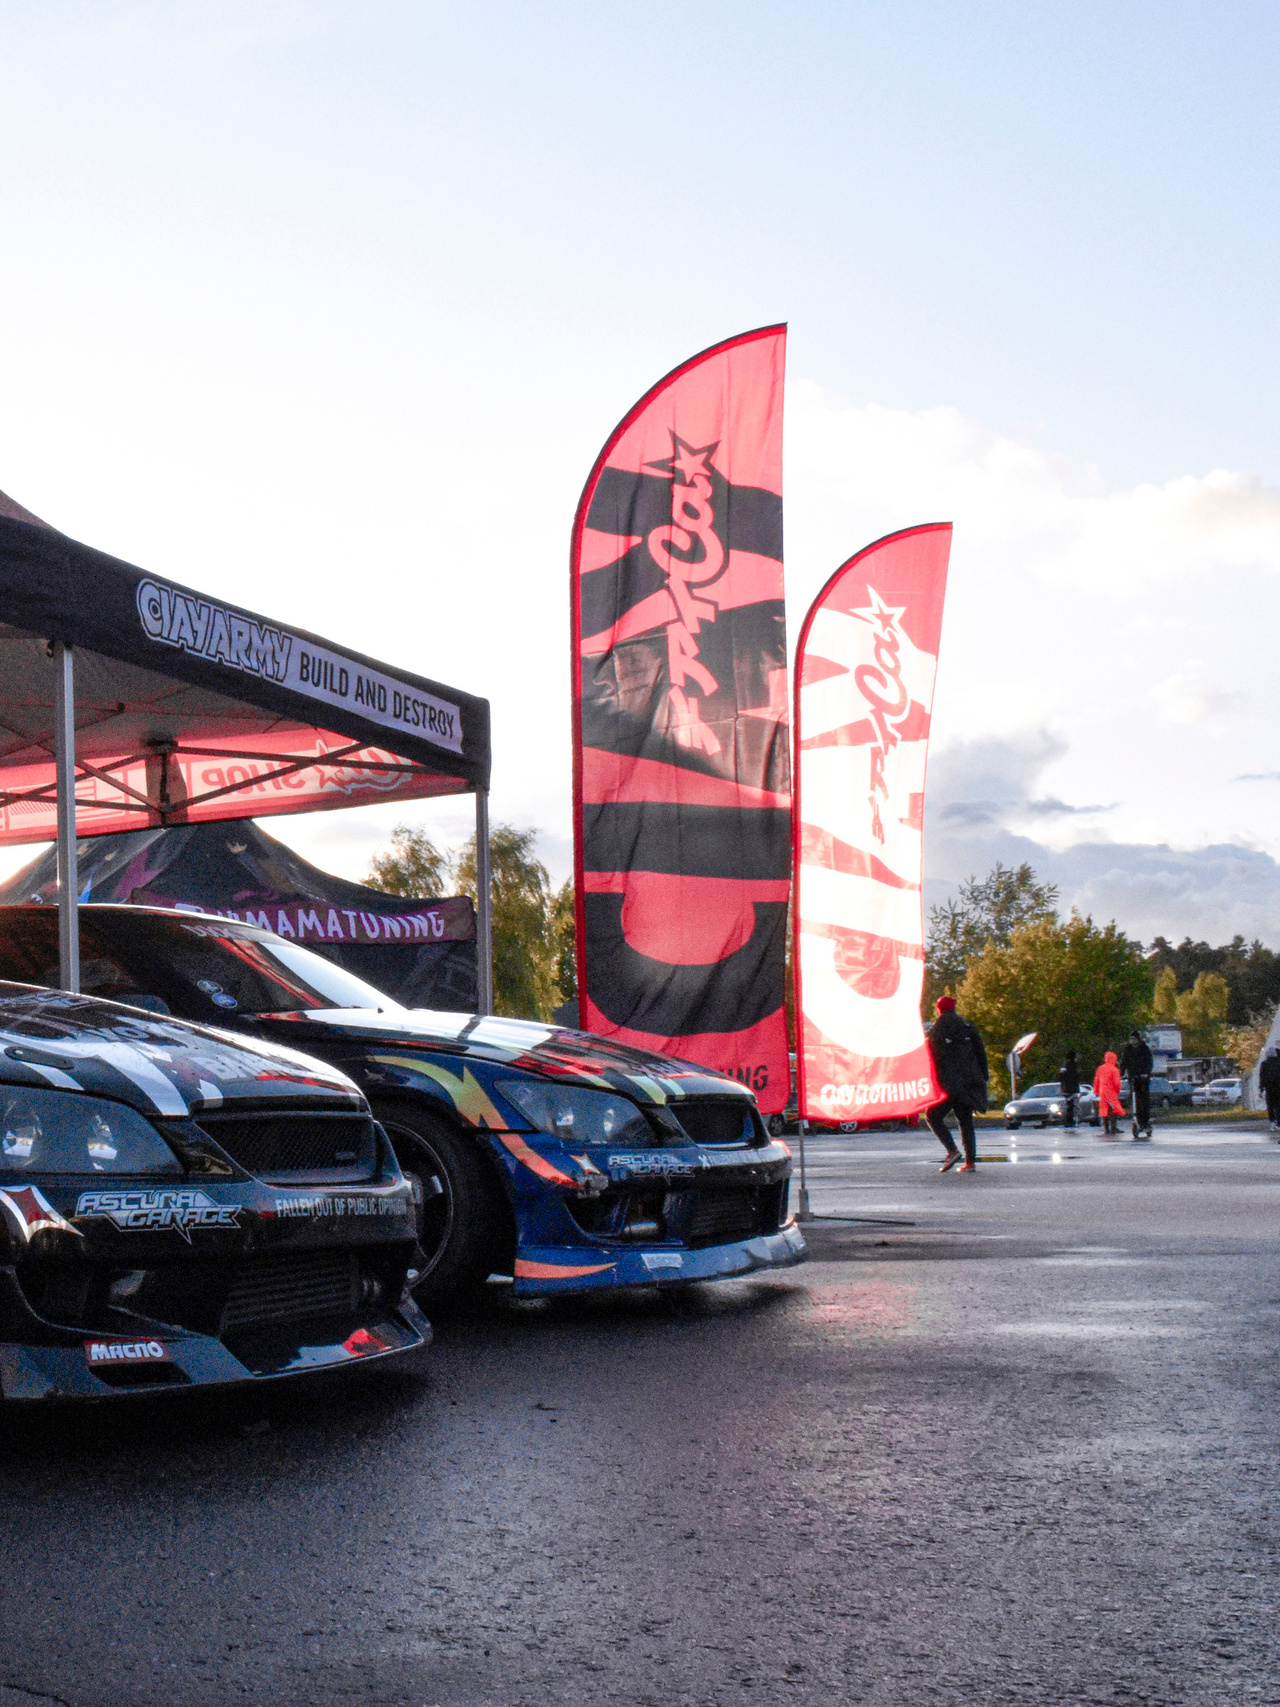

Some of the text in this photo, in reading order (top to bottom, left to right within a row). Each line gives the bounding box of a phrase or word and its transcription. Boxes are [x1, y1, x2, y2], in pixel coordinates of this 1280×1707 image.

[299, 652, 351, 698] BUILD
[353, 675, 387, 713] AND
[392, 689, 456, 741] DESTROY
[218, 908, 445, 939] MAMATUNING
[78, 1191, 196, 1212] ASCURA
[275, 1198, 315, 1217] FALLEN
[315, 1198, 334, 1216] OUT
[334, 1198, 346, 1216] OF
[347, 1197, 378, 1215] PUBLIC
[124, 1207, 237, 1231] GARAGE
